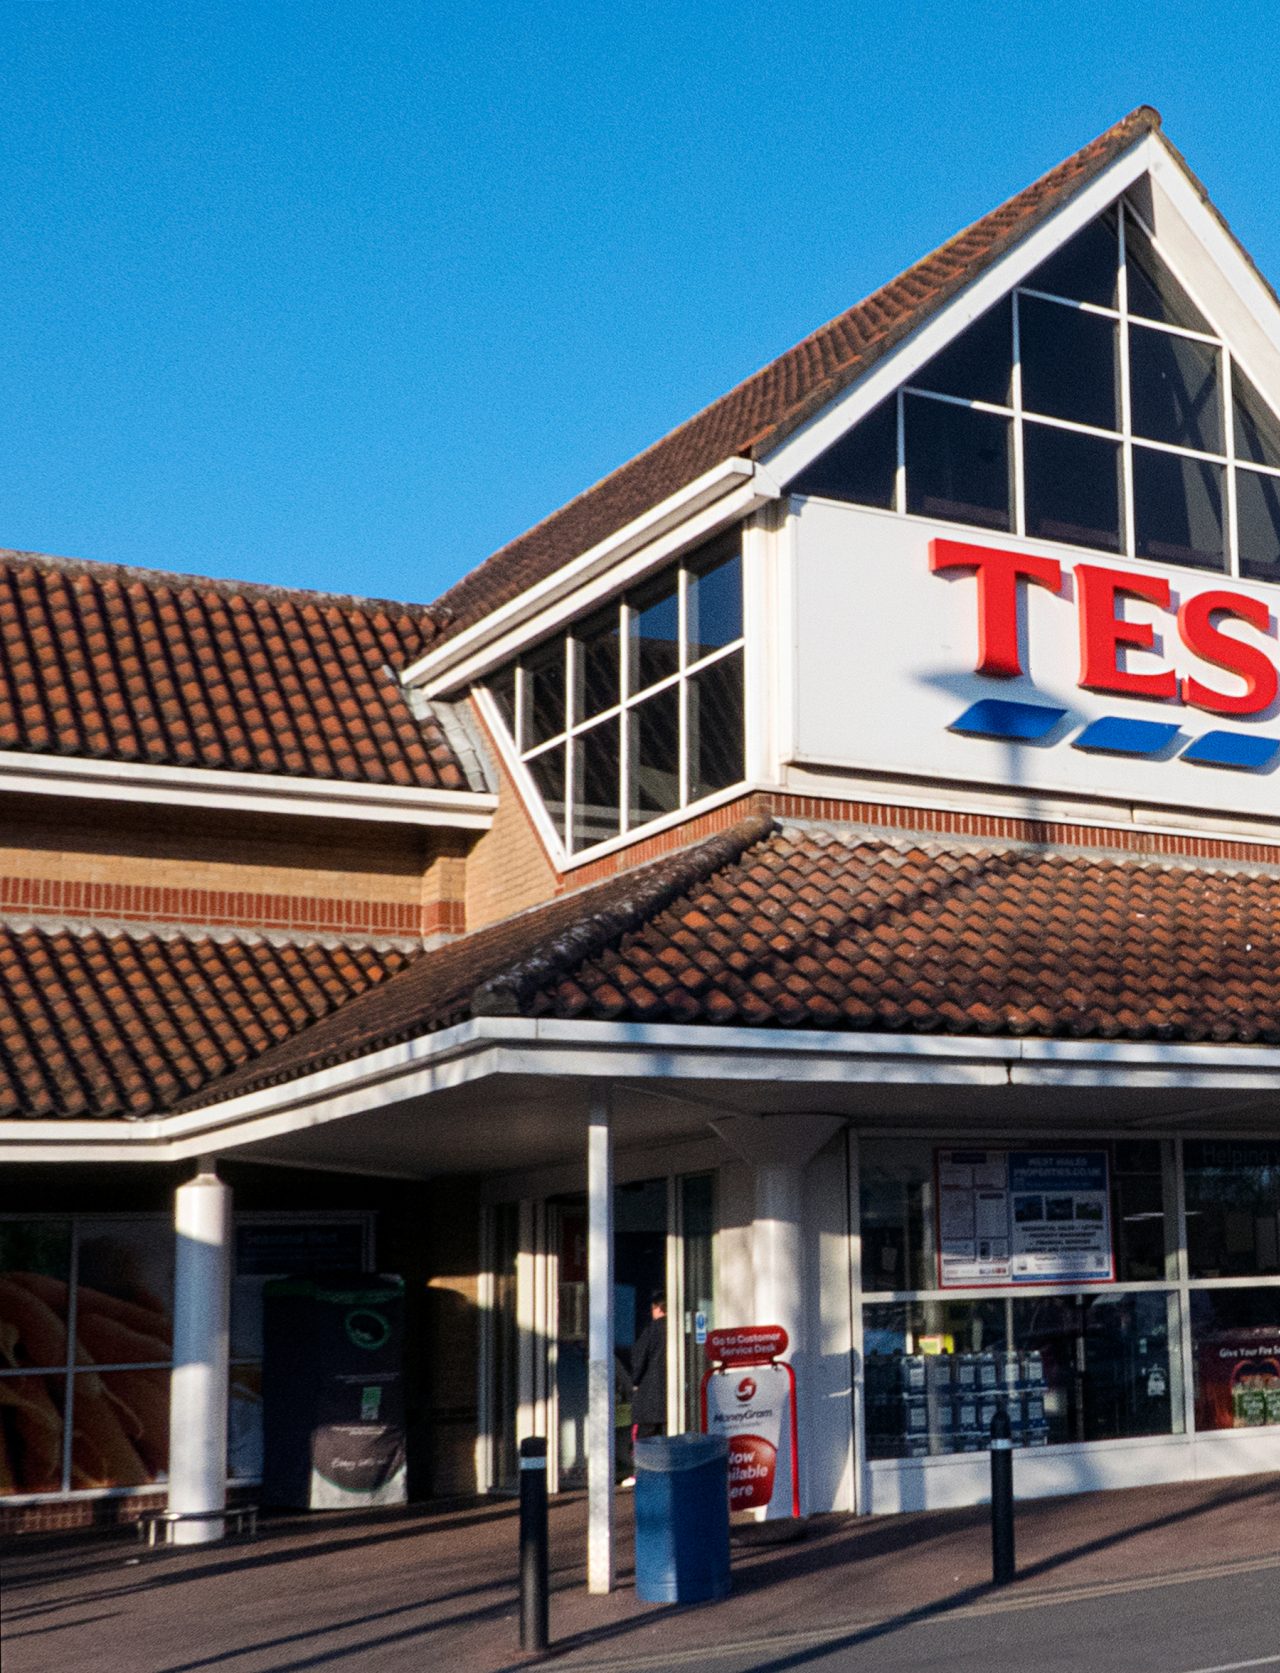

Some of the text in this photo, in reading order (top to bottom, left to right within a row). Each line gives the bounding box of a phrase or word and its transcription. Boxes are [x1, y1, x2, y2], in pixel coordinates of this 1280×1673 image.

[1202, 1143, 1269, 1169] Helping
[712, 1336, 725, 1346] Go
[726, 1336, 736, 1345] to
[737, 1333, 782, 1344] Customer
[720, 1343, 776, 1357] Service Desk
[1219, 1348, 1238, 1358] Give
[1239, 1348, 1257, 1357] Your
[1258, 1346, 1272, 1355] Fire
[714, 1409, 773, 1423] MoneyGram
